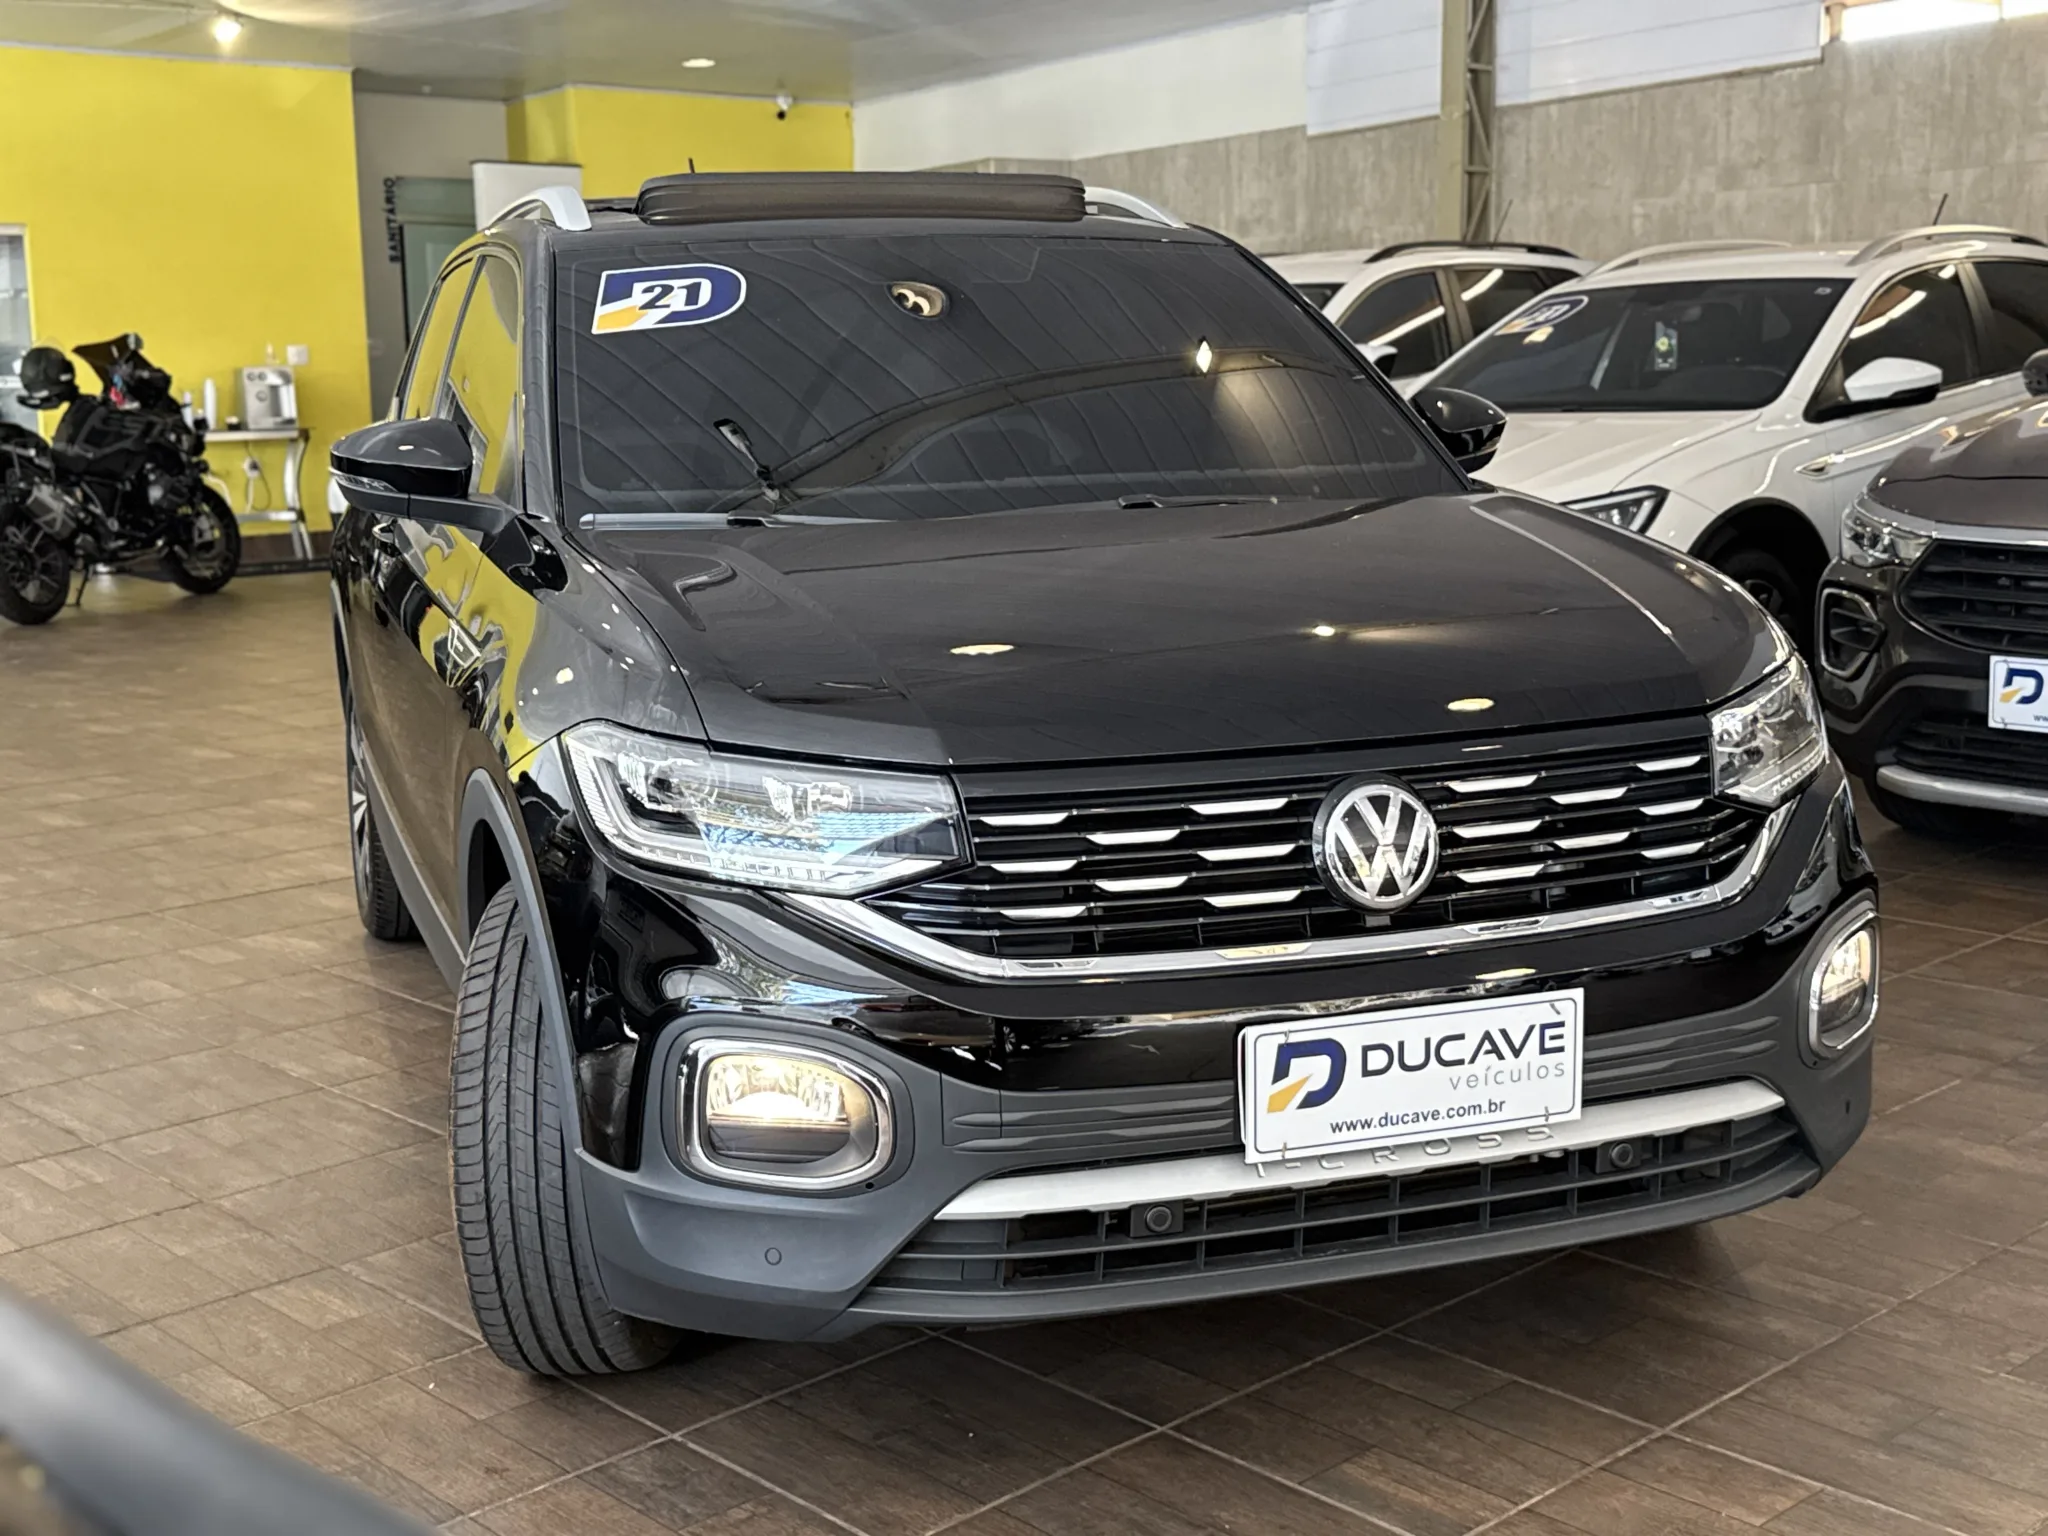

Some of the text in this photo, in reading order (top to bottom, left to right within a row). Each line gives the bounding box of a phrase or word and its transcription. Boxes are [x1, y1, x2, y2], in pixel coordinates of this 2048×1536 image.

[638, 280, 703, 311] 21
[1324, 783, 1437, 911] VW
[1360, 1020, 1566, 1078] DUCAVE
[1449, 1060, 1566, 1092] veículos
[1329, 1098, 1507, 1134] www.ducave.com.br
